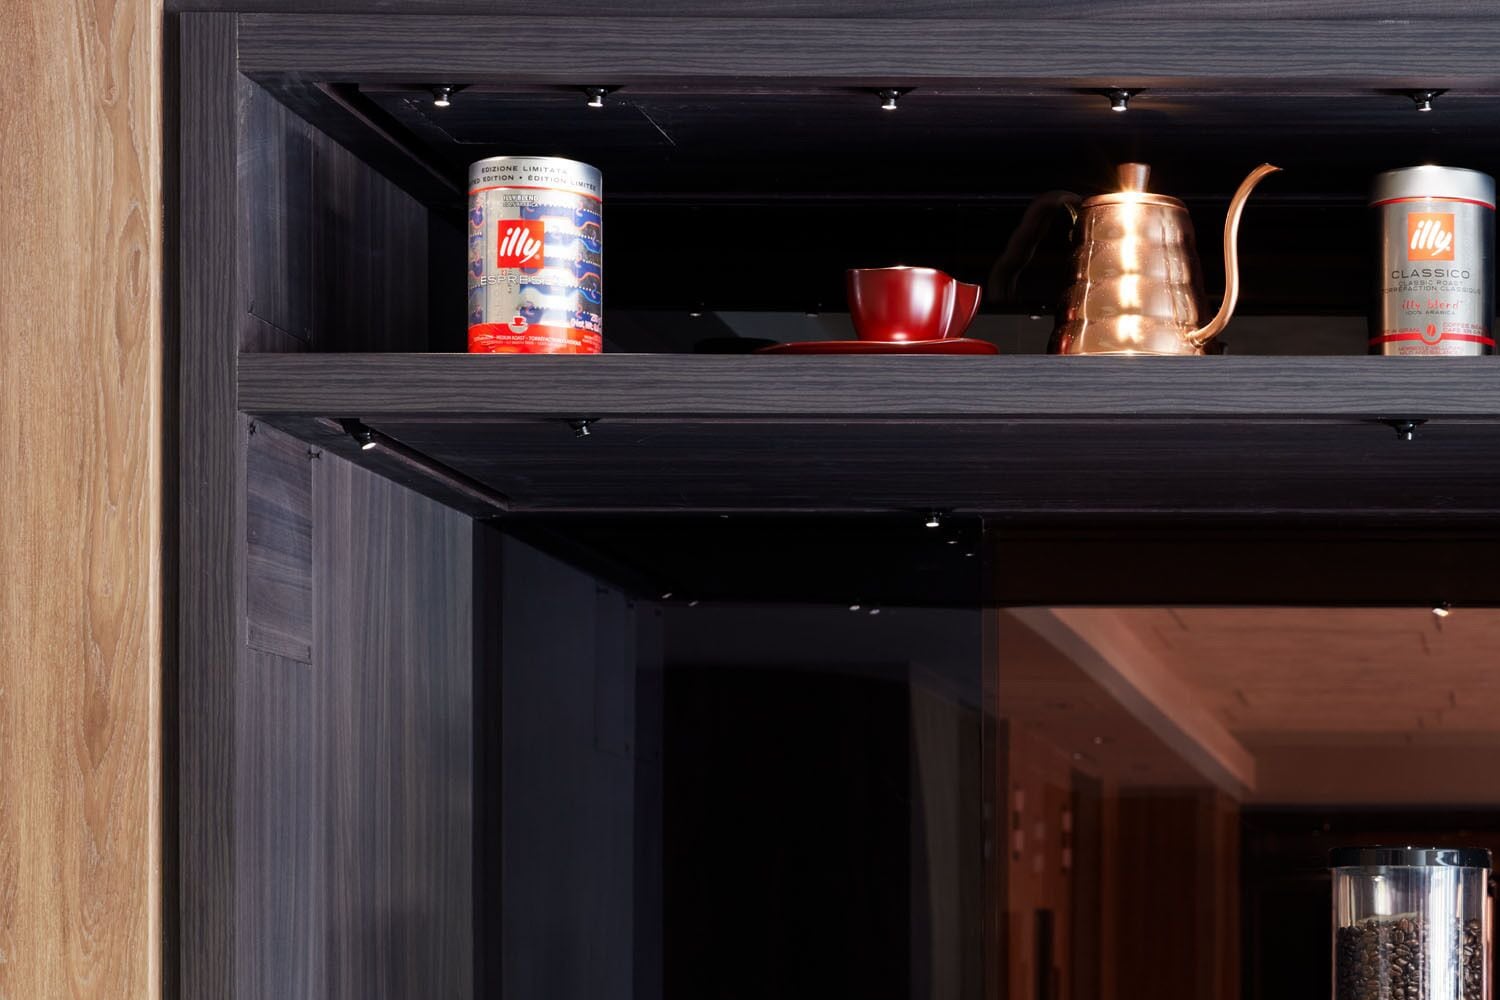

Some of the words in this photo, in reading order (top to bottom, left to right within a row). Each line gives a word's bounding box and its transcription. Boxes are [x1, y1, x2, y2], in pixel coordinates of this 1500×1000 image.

[481, 165, 518, 174] EDIZIONE
[522, 165, 568, 174] LIMITATA
[482, 174, 514, 182] EDITION
[1410, 219, 1453, 257] illy
[500, 226, 542, 264] illy
[1391, 268, 1471, 279] CLASSICO
[480, 275, 557, 287] ESPRES
